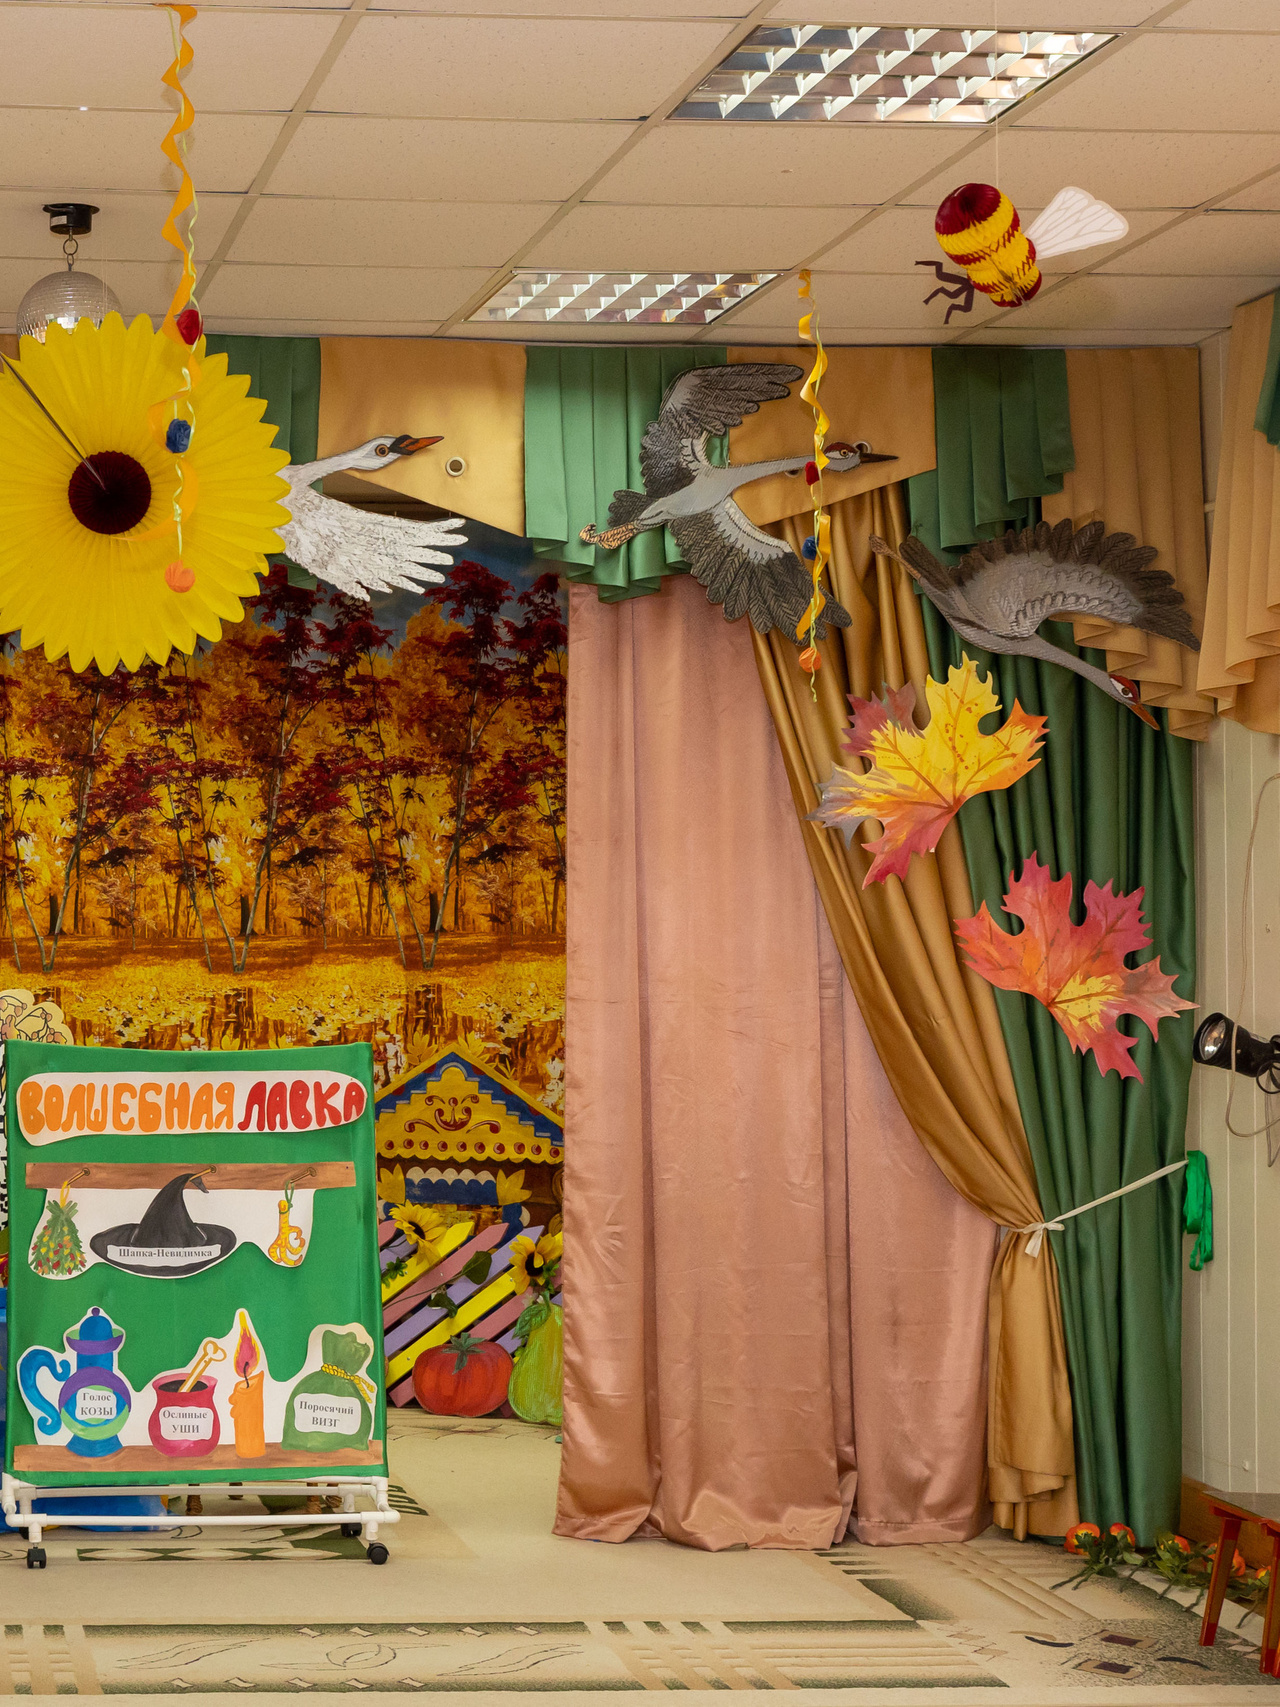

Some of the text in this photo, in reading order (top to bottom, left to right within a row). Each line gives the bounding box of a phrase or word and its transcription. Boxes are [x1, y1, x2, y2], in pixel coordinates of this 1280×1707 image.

[19, 1079, 365, 1135] ВОЛШЕБНАЯ ЛАВКА
[118, 1247, 213, 1258] Шапка-Невидимка
[82, 1392, 112, 1402] Голос
[80, 1406, 114, 1417] КОЗЫ
[299, 1400, 355, 1415] Поросячий
[162, 1409, 208, 1420] Ослиные
[311, 1416, 341, 1428] ВИЗГ
[171, 1423, 200, 1434] УШИ
